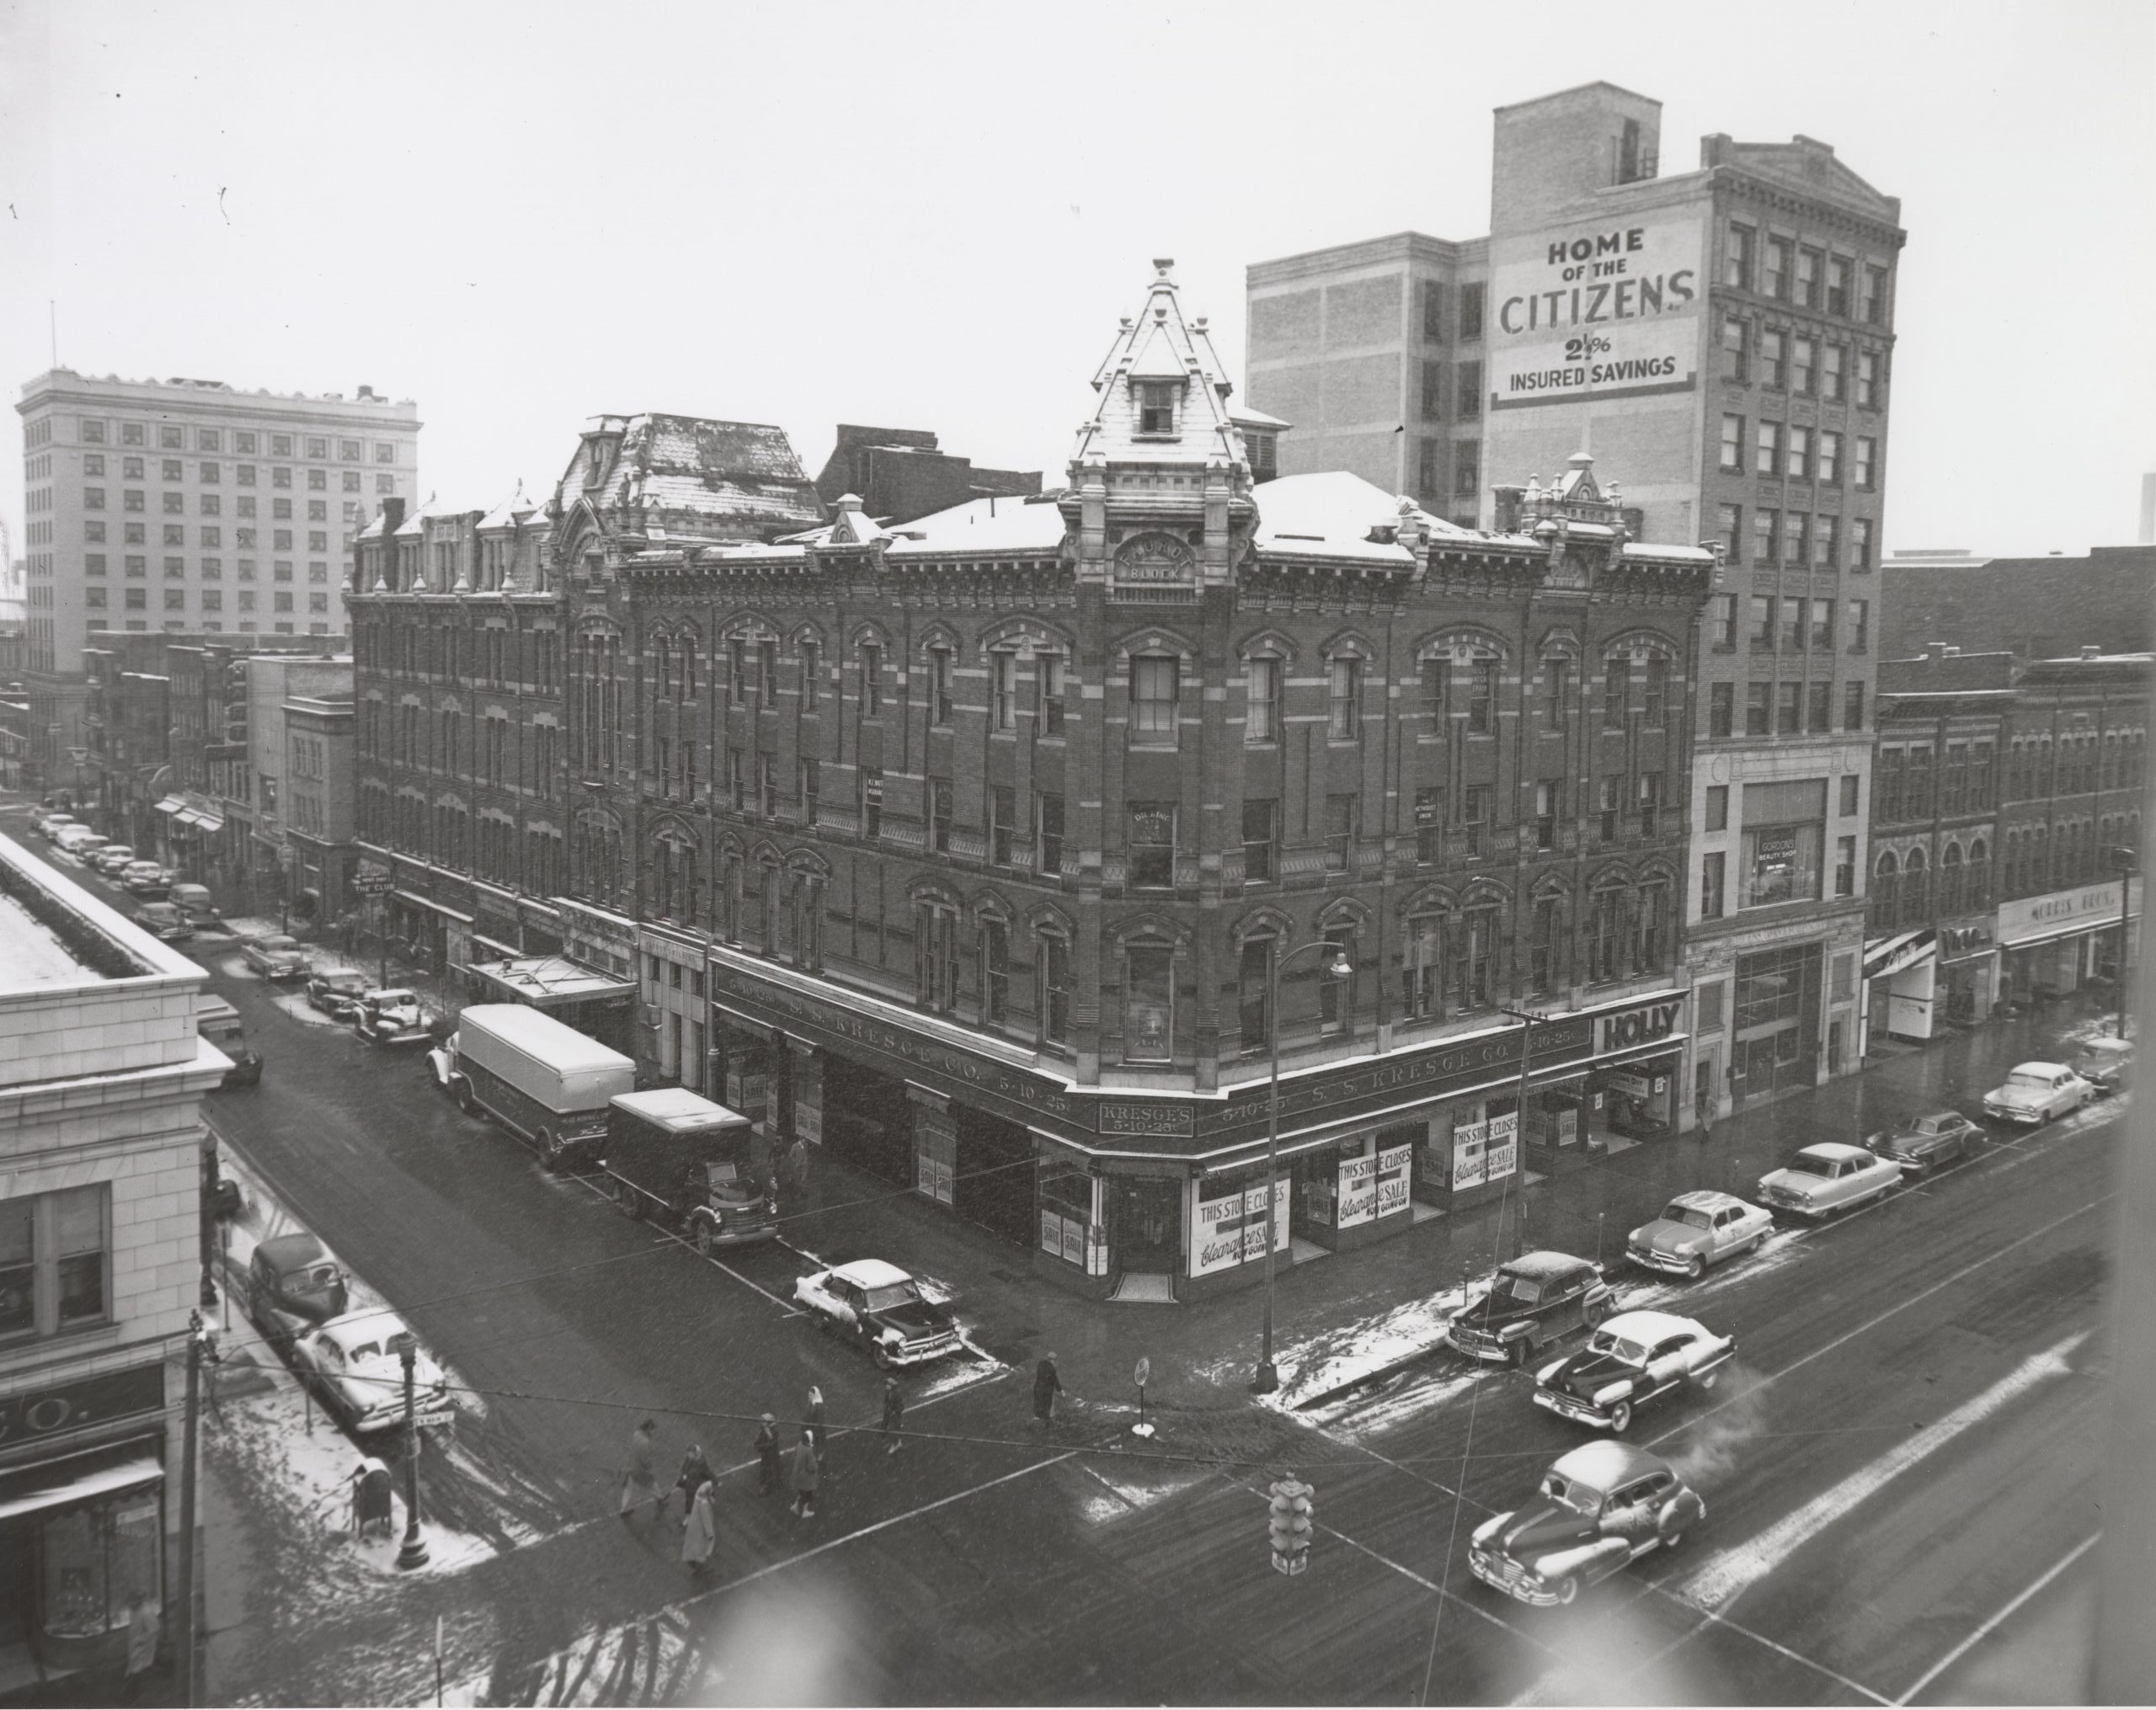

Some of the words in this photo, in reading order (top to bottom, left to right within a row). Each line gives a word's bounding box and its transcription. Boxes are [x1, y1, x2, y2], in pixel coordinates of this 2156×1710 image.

[1548, 228, 1644, 265] HOME
[1562, 265, 1585, 282] OF
[1593, 258, 1627, 278] THE
[1500, 269, 1694, 334] CITIZENS
[1510, 367, 1585, 392] INSURED
[1592, 356, 1676, 384] SAVINGS
[1131, 568, 1178, 579] BLOCK
[1604, 1003, 1681, 1051] HOLLY
[812, 1009, 825, 1023] S.
[836, 1018, 931, 1062] KRESGE
[945, 1055, 980, 1080] CO.
[1312, 1086, 1327, 1102] S.
[1342, 1080, 1358, 1095] S.
[1372, 1054, 1470, 1089] KRESGE
[1482, 1044, 1508, 1062] CO.
[1103, 1106, 1191, 1123] KRESGE'S
[1454, 1128, 1471, 1147] THIS
[1472, 1123, 1493, 1141] STOE
[1494, 1116, 1518, 1135] CLOSES
[1339, 1163, 1358, 1180] THIS
[1385, 1148, 1412, 1169] CLOSES
[1479, 1169, 1490, 1180] NO
[1491, 1166, 1507, 1176] GOING
[1508, 1162, 1514, 1171] ON
[1497, 1146, 1515, 1165] SALE
[1200, 1203, 1223, 1223] THIS
[1254, 1185, 1284, 1210] CLOES
[1340, 1186, 1385, 1222] Clearane
[1385, 1180, 1407, 1201] SALE
[1380, 1200, 1399, 1212] GOING
[1399, 1196, 1407, 1206] ON
[1256, 1221, 1280, 1243] SAE
[1248, 1243, 1267, 1256] GOIN
